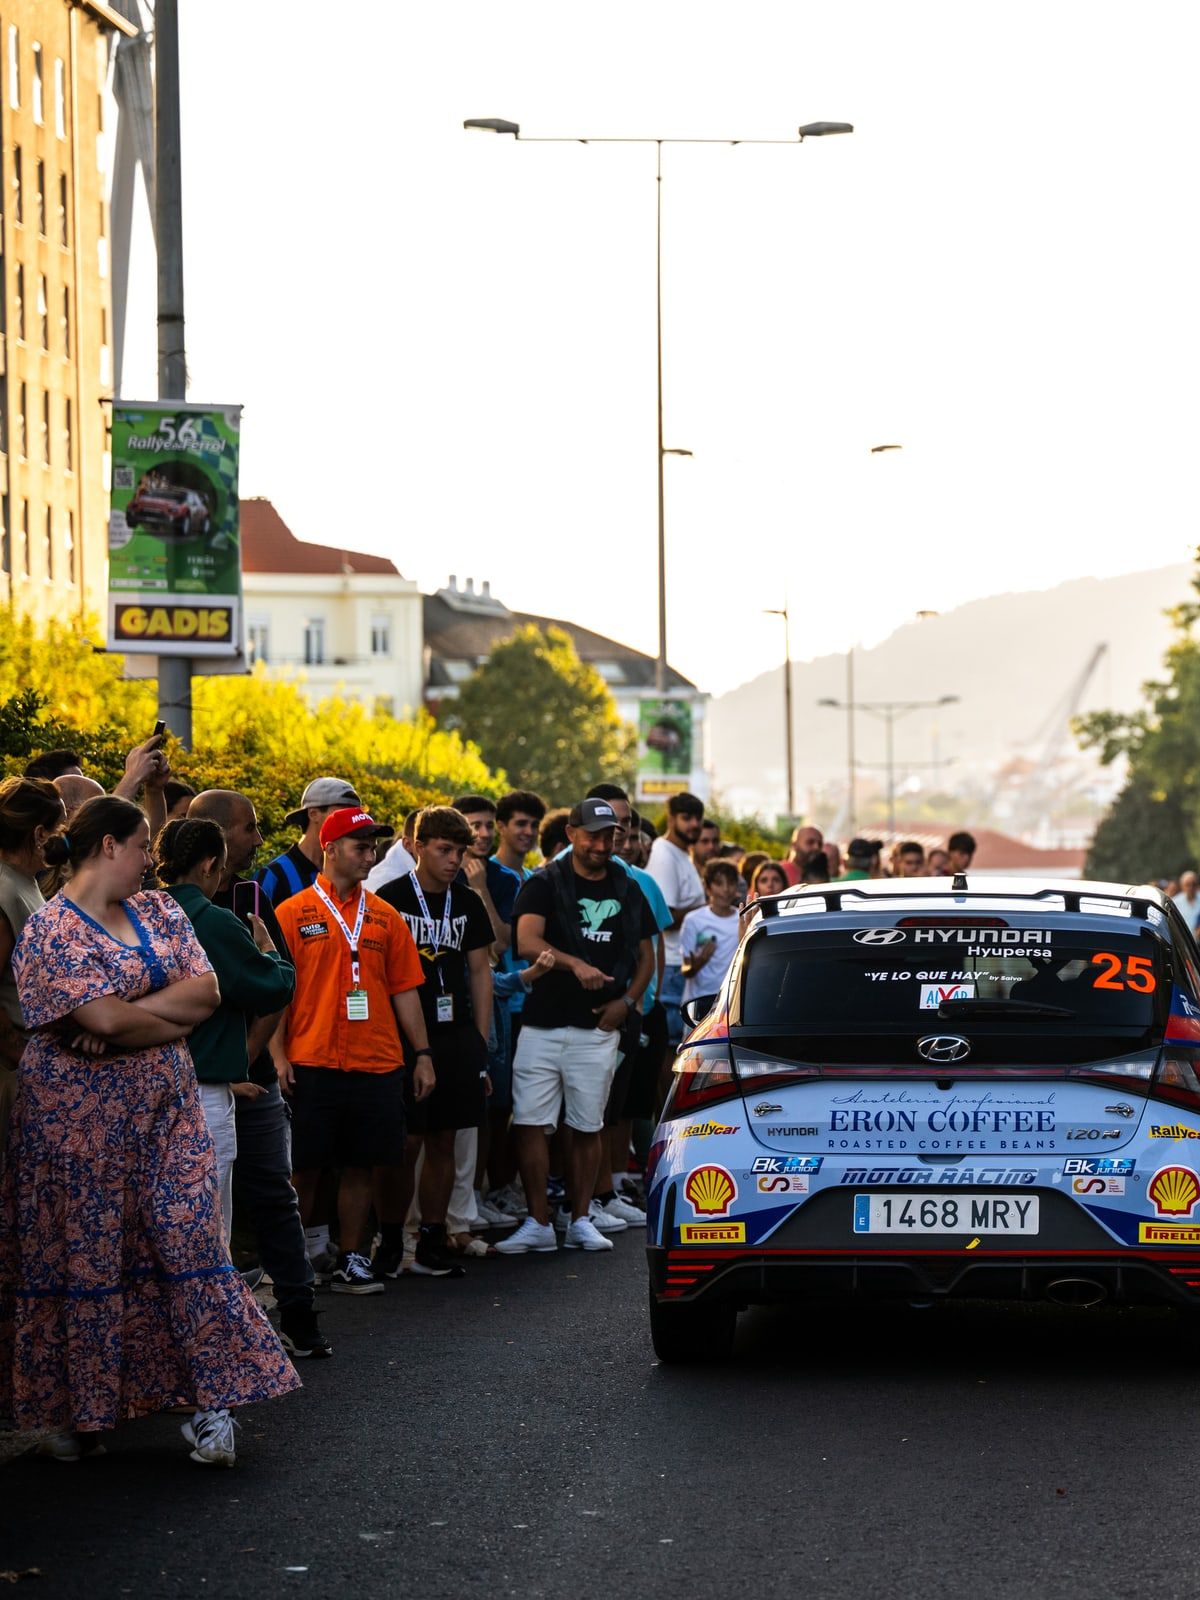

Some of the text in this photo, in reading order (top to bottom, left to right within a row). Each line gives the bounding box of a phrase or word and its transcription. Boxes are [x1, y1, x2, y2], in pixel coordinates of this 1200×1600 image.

[159, 417, 198, 443] 56
[128, 435, 171, 453] Rallye
[182, 437, 226, 453] Ferrol
[120, 606, 230, 638] GADIS
[399, 911, 468, 951] VELAST
[914, 929, 1052, 944] HYUNDAI
[967, 946, 1052, 958] Hyupersa
[891, 971, 912, 981] LO
[915, 971, 948, 980] QUE
[989, 975, 1000, 983] by
[1091, 952, 1157, 993] 25
[828, 1110, 1056, 1132] ERON COFFEE
[683, 1123, 741, 1136] Rallycar
[767, 1127, 819, 1137] HYUNDAI
[828, 1140, 1056, 1149] ROASTED COFFEE BEANS
[859, 1200, 1031, 1229] E 1468 MRY
[686, 1226, 740, 1240] PIRELLI
